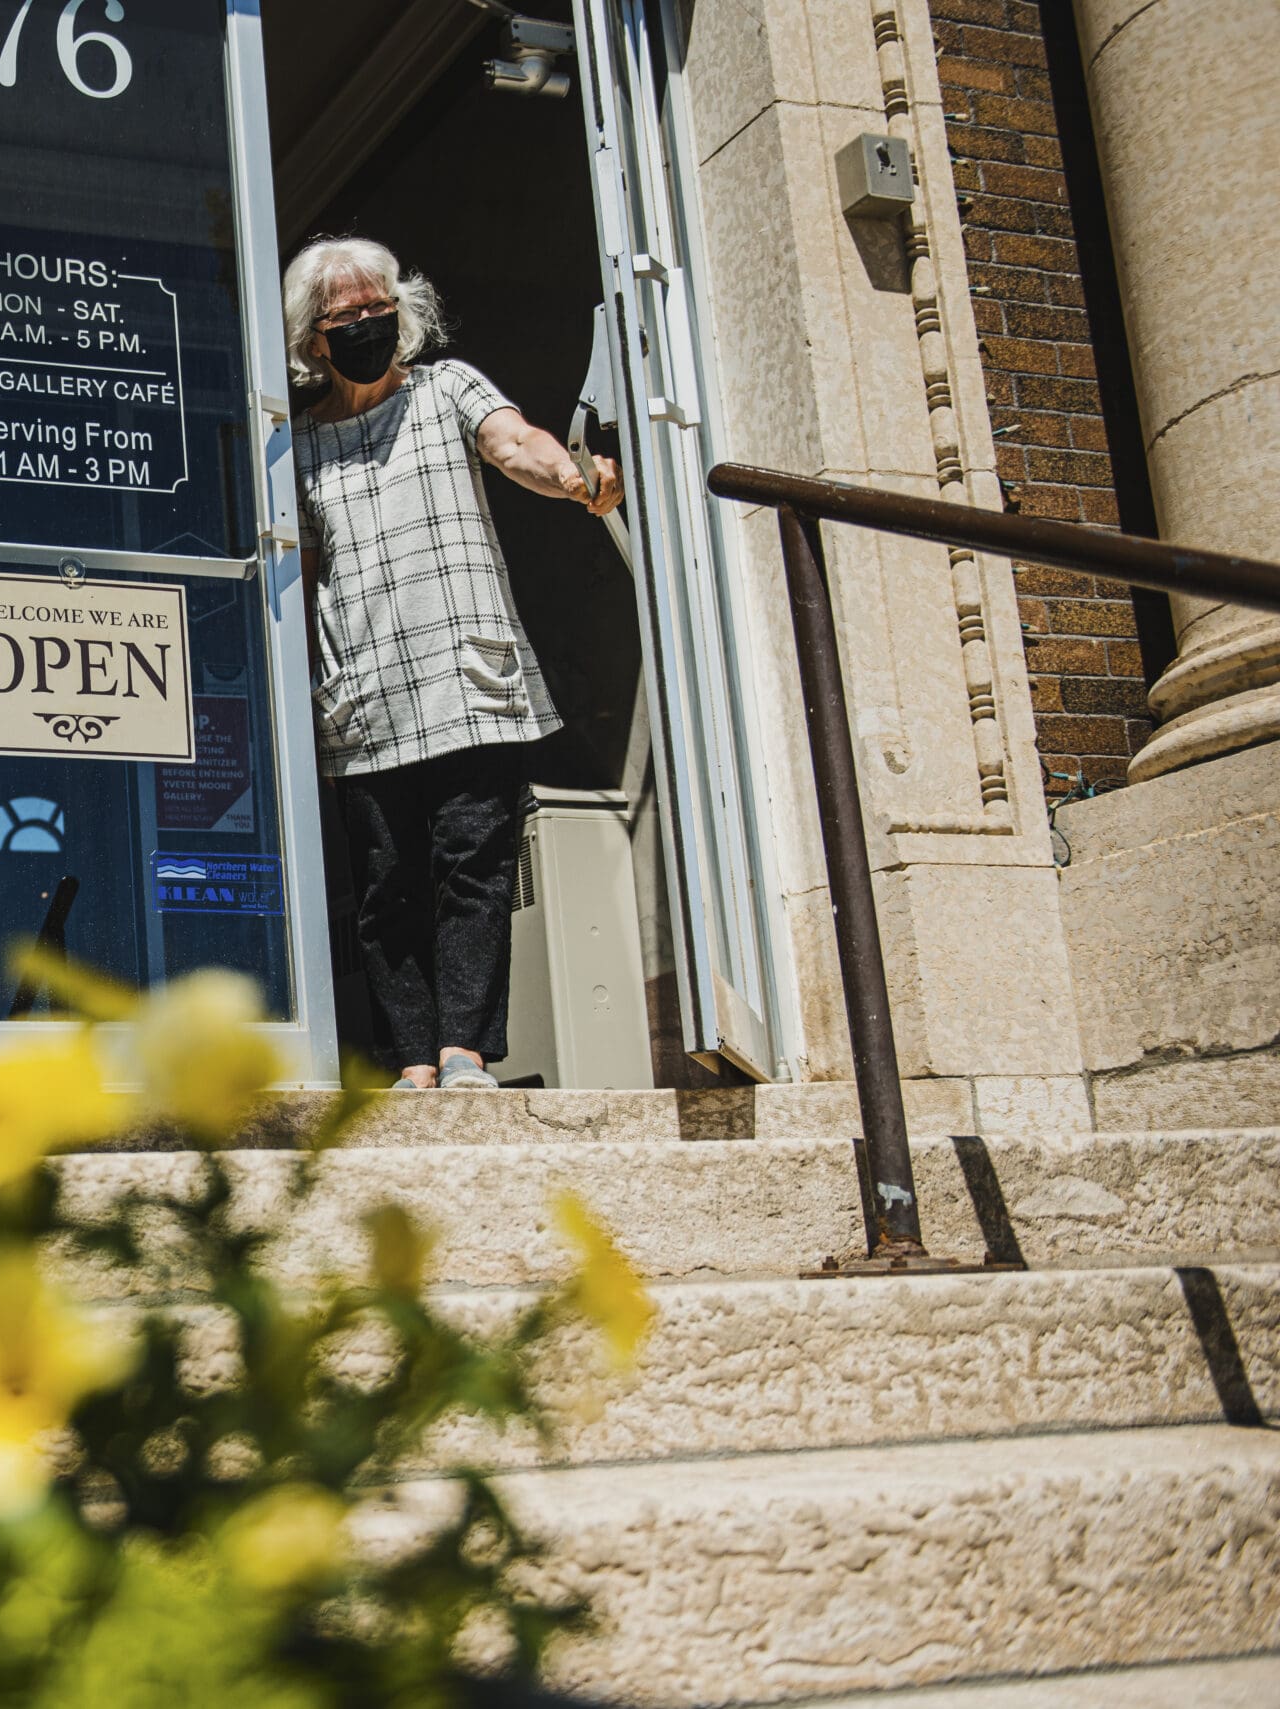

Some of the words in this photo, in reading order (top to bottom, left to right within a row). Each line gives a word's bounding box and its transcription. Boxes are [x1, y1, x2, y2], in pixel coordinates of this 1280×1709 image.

[73, 300, 124, 324] SAT.
[0, 322, 53, 345] A.M.
[77, 330, 91, 349] 5
[99, 331, 147, 354] P.M.
[114, 382, 176, 404] CAFÉ
[85, 422, 153, 451] From
[17, 452, 60, 479] AM
[85, 457, 100, 482] 3
[108, 459, 150, 485] PM
[89, 610, 122, 626] WE
[128, 613, 169, 629] ARE
[215, 735, 232, 743] THE
[162, 768, 196, 777] BEFORE
[199, 769, 244, 779] ENTERING
[162, 780, 196, 789] YVETTE
[198, 782, 232, 791] MOORE
[163, 791, 205, 801] GALLERY.
[206, 862, 247, 871] Northern
[249, 863, 274, 872] Water
[206, 870, 247, 880] Cleaners
[158, 886, 234, 902] KLEAN
